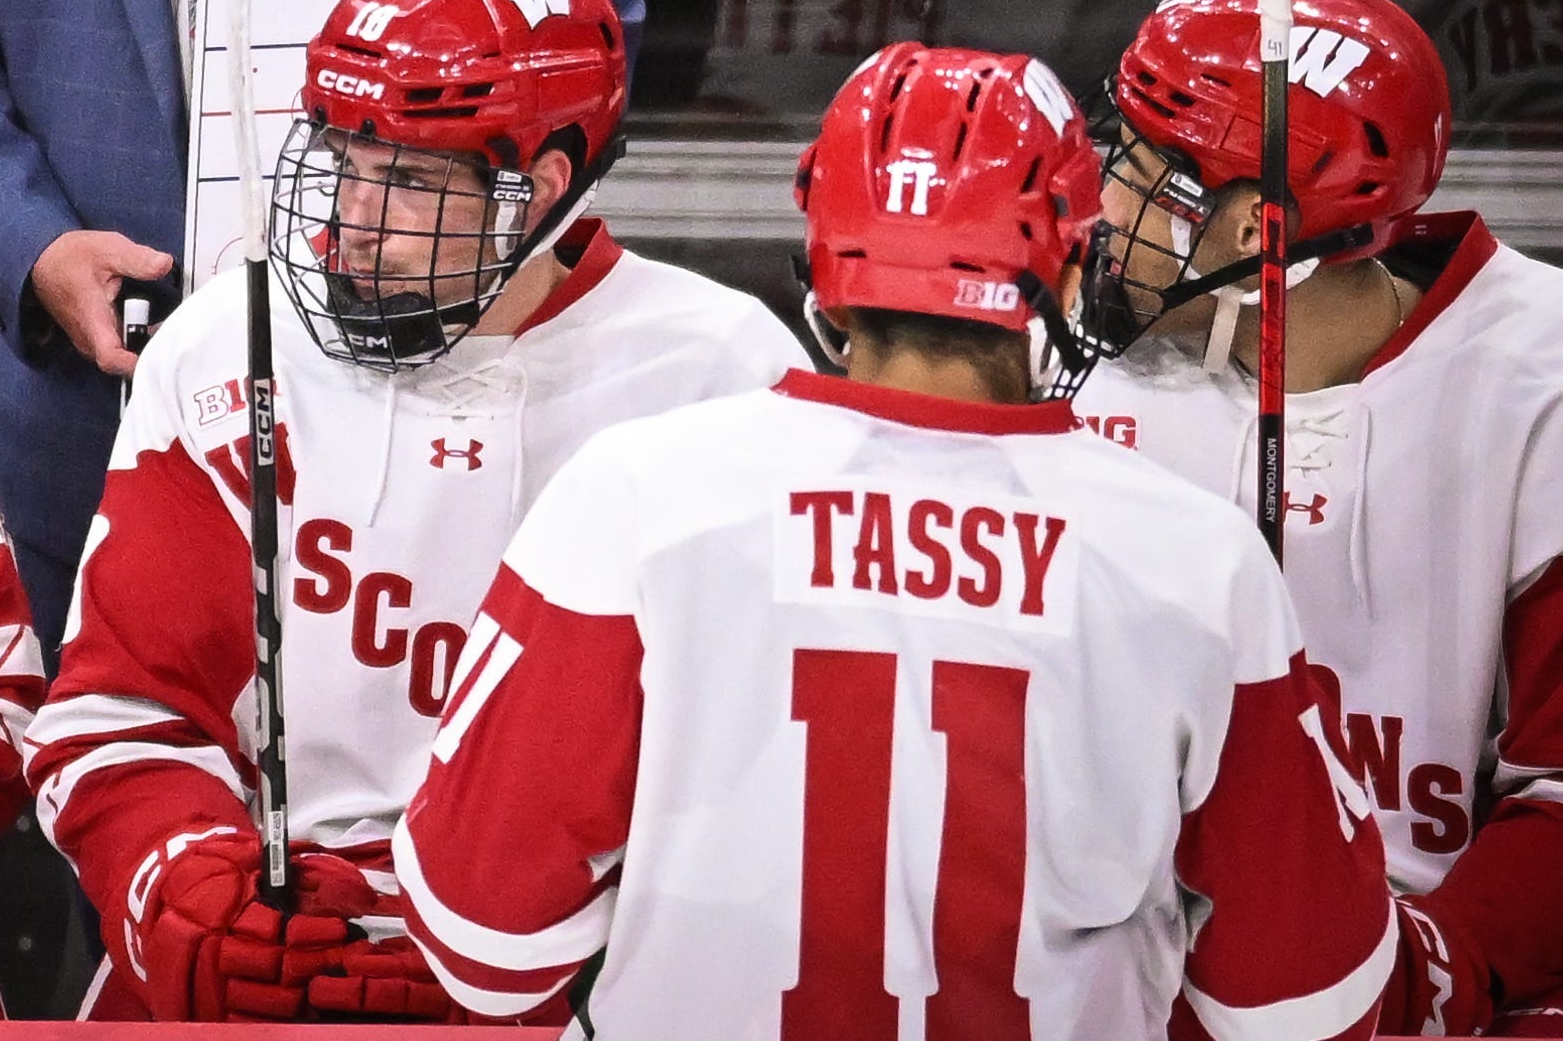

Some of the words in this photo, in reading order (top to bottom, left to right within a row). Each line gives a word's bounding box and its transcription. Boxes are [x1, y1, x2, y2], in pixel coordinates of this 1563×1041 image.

[345, 1, 399, 42] 18
[317, 69, 385, 100] CCM
[1288, 26, 1371, 99] W
[492, 190, 532, 202] CCM
[255, 384, 273, 460] CCM
[1265, 437, 1279, 524] MONTGOMERY
[789, 490, 1067, 617] TASSY
[778, 648, 1032, 1041] 11
